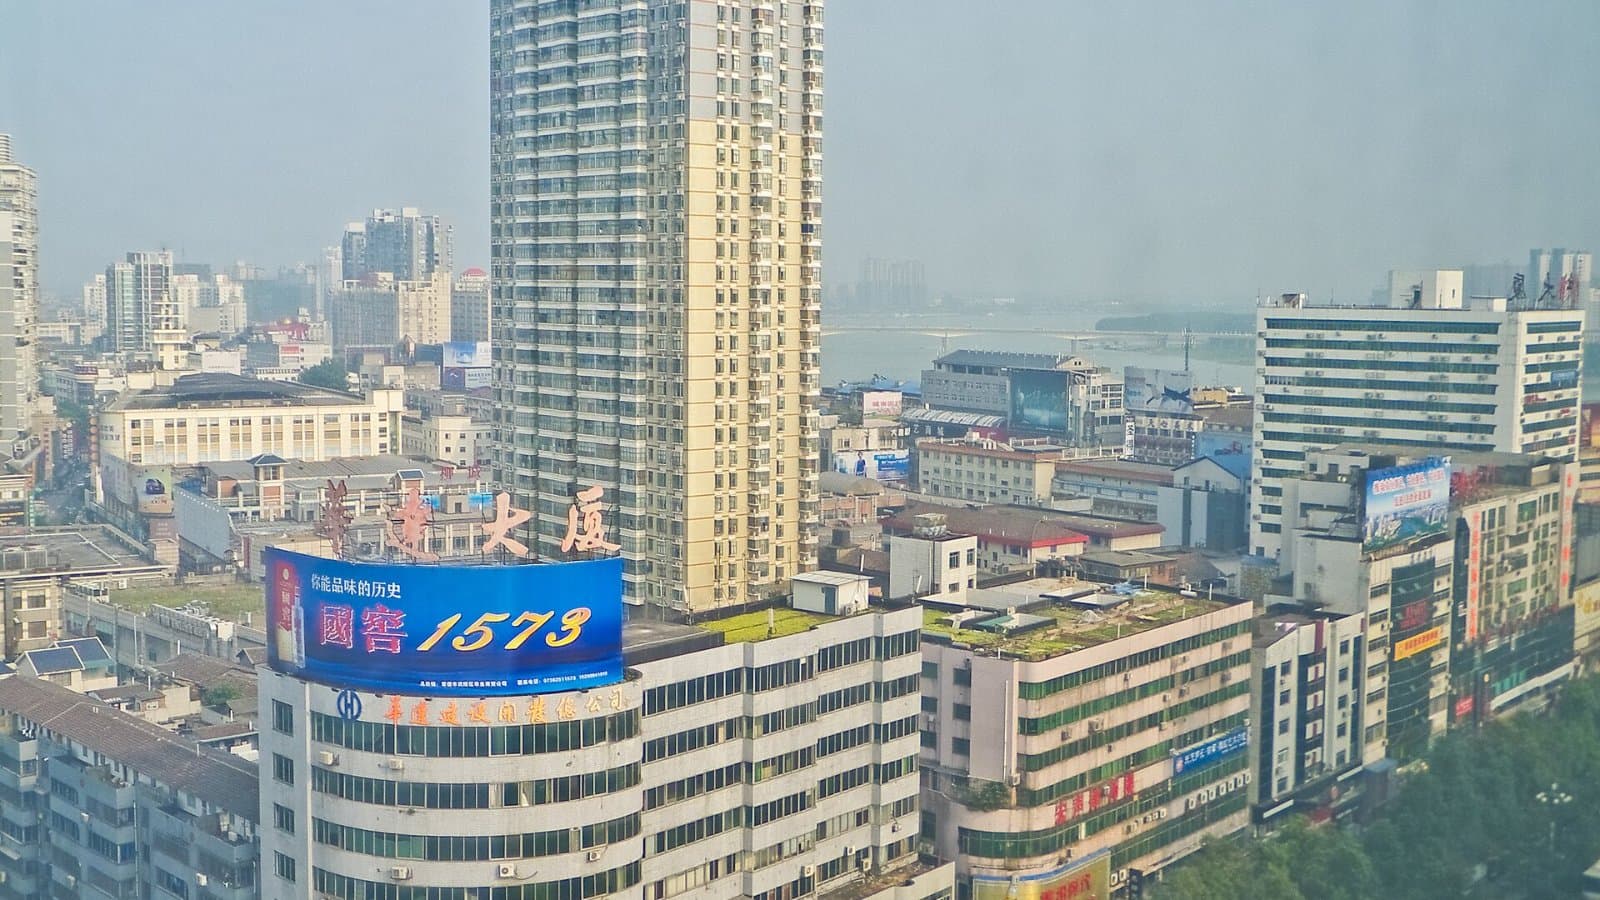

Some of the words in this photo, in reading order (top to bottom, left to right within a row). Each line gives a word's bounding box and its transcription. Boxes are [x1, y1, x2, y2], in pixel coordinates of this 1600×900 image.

[312, 573, 402, 598] 你能品味的历史
[320, 603, 408, 653] 國窖
[416, 607, 593, 651] 1573
